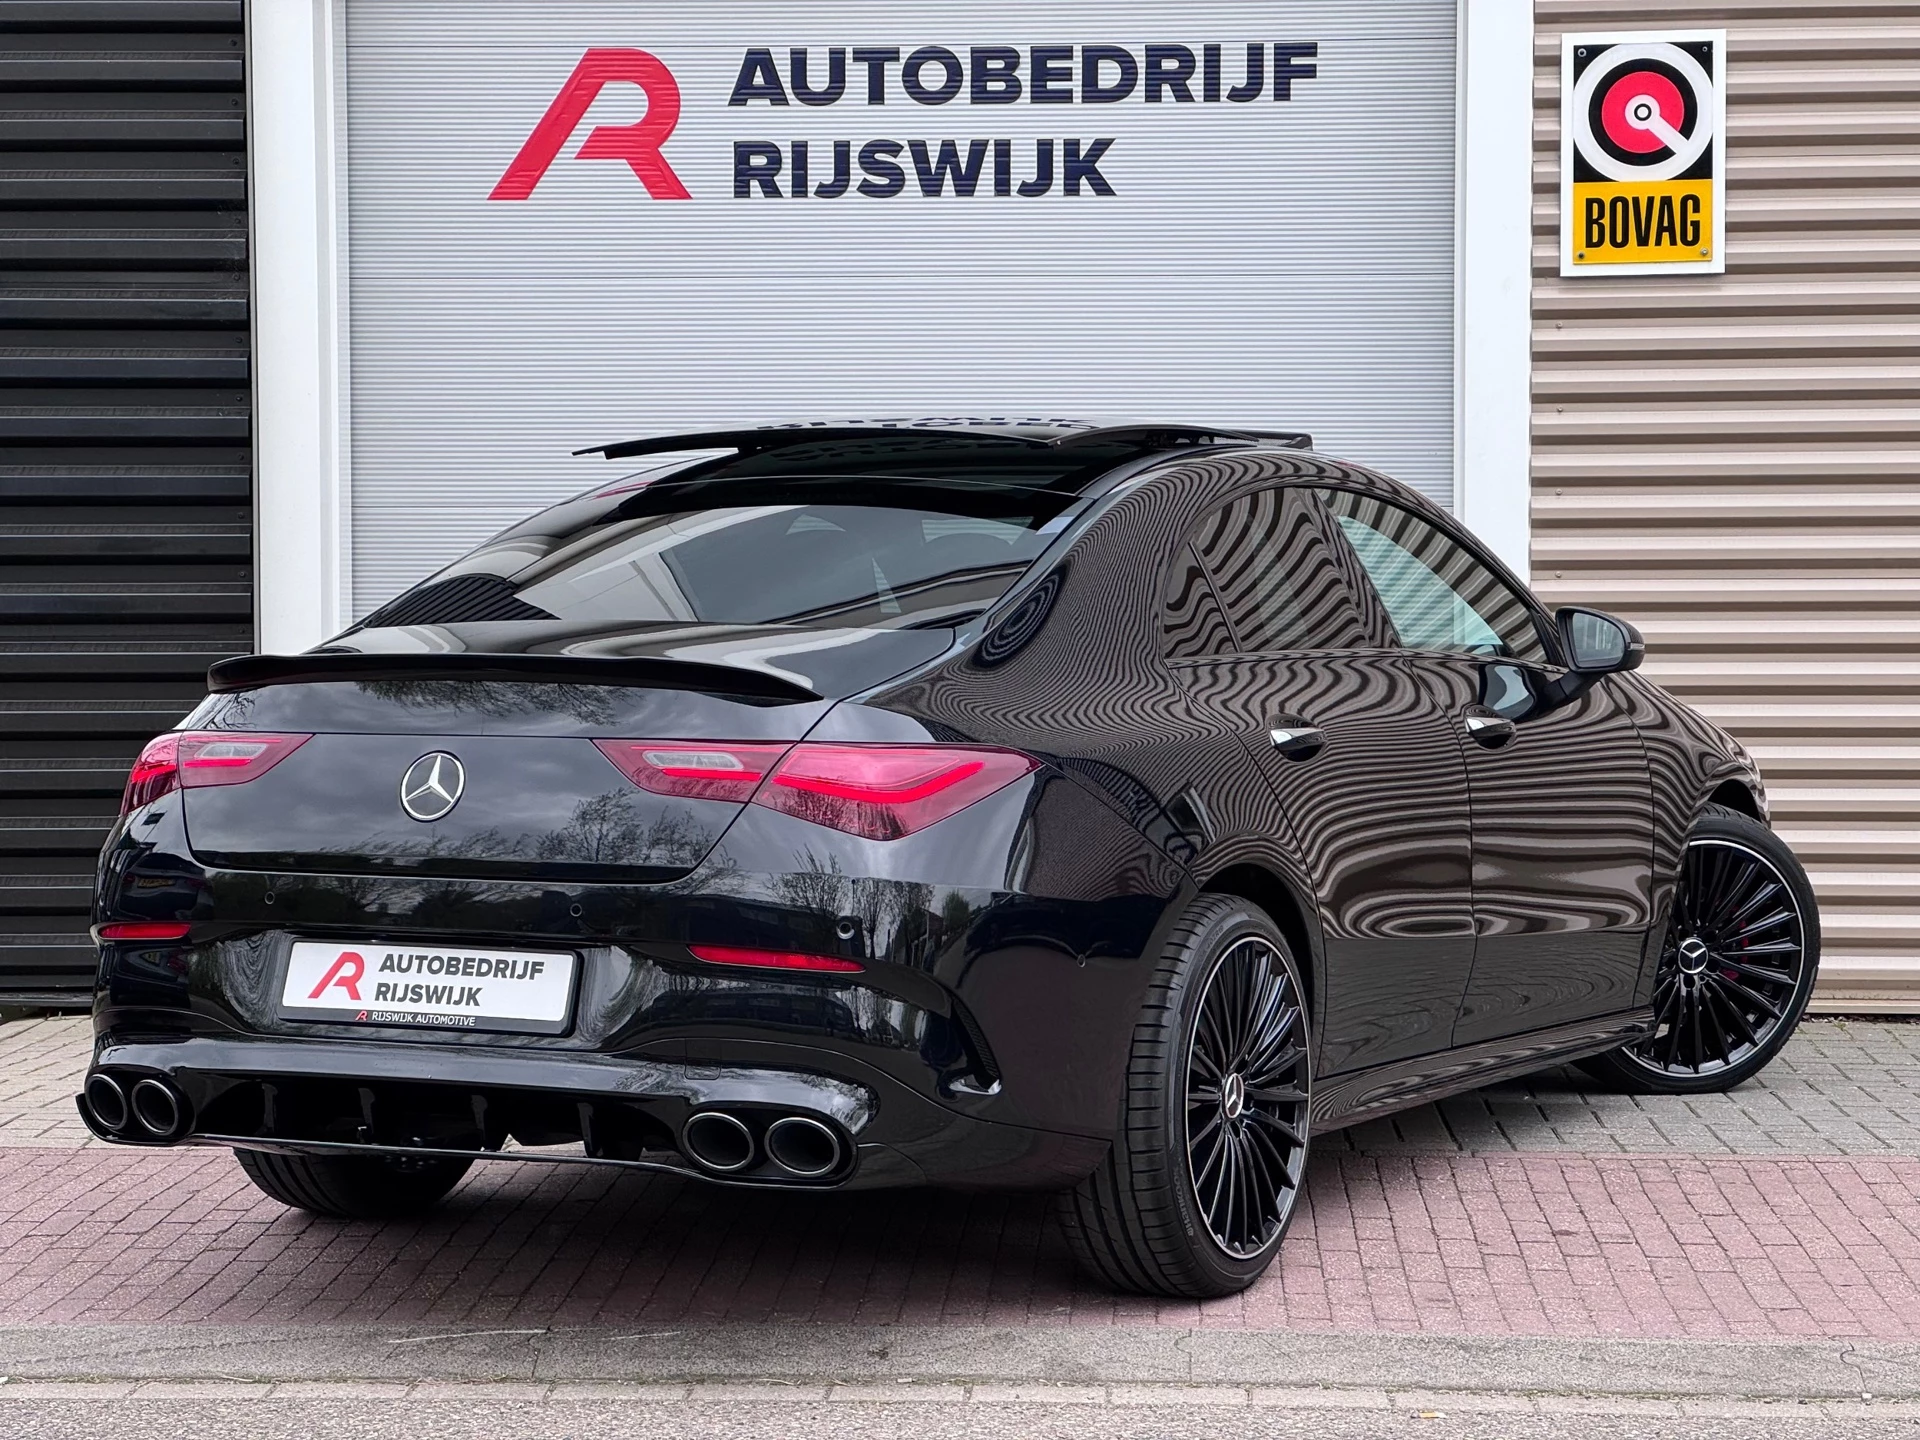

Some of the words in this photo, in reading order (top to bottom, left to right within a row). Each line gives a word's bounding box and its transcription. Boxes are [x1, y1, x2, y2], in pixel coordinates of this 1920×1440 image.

[728, 42, 1318, 107] AUTOBEDRIJF
[733, 138, 1118, 199] RIJSWIJK
[1585, 194, 1701, 249] BOVAG
[378, 953, 545, 980] AUTOBEDRIJF
[374, 982, 483, 1007] RIJSWIJK
[371, 1011, 414, 1023] RIJSWIJK
[415, 1014, 476, 1026] AUTOMOTIVE
